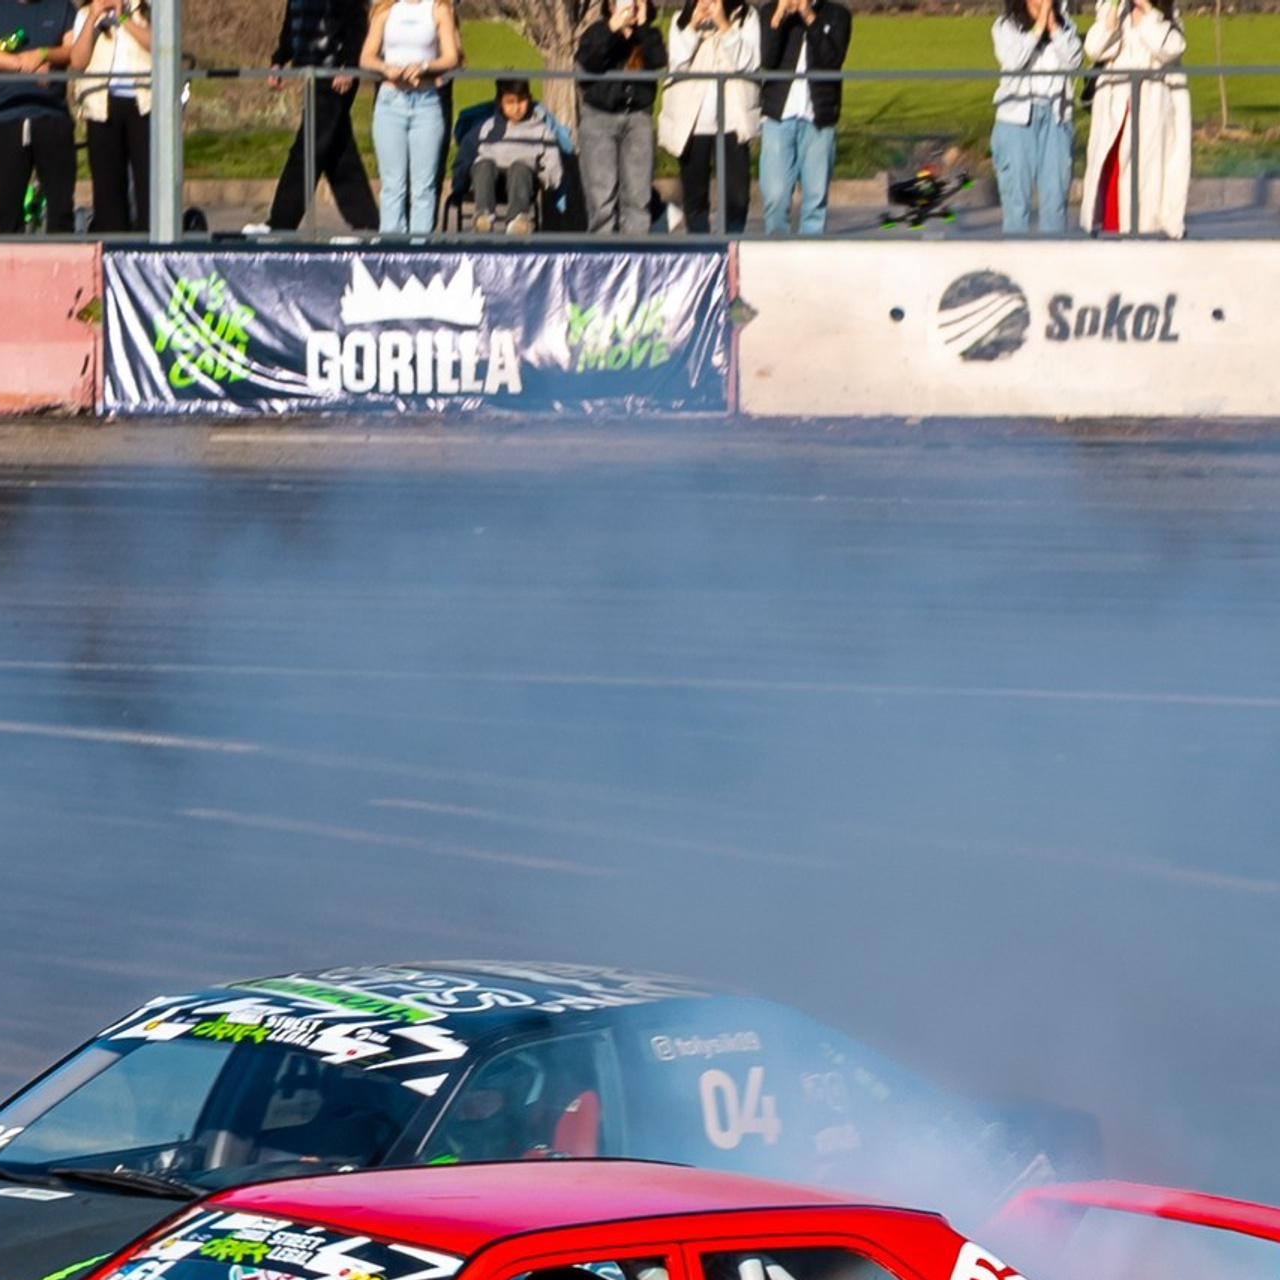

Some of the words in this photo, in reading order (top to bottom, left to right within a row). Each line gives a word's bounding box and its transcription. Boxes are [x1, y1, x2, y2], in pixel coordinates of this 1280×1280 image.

[306, 330, 521, 395] GORILLA
[264, 1015, 324, 1032] STREET
[699, 1066, 782, 1150] 04
[267, 1231, 326, 1250] STREET
[266, 1246, 315, 1266] LEGAL
